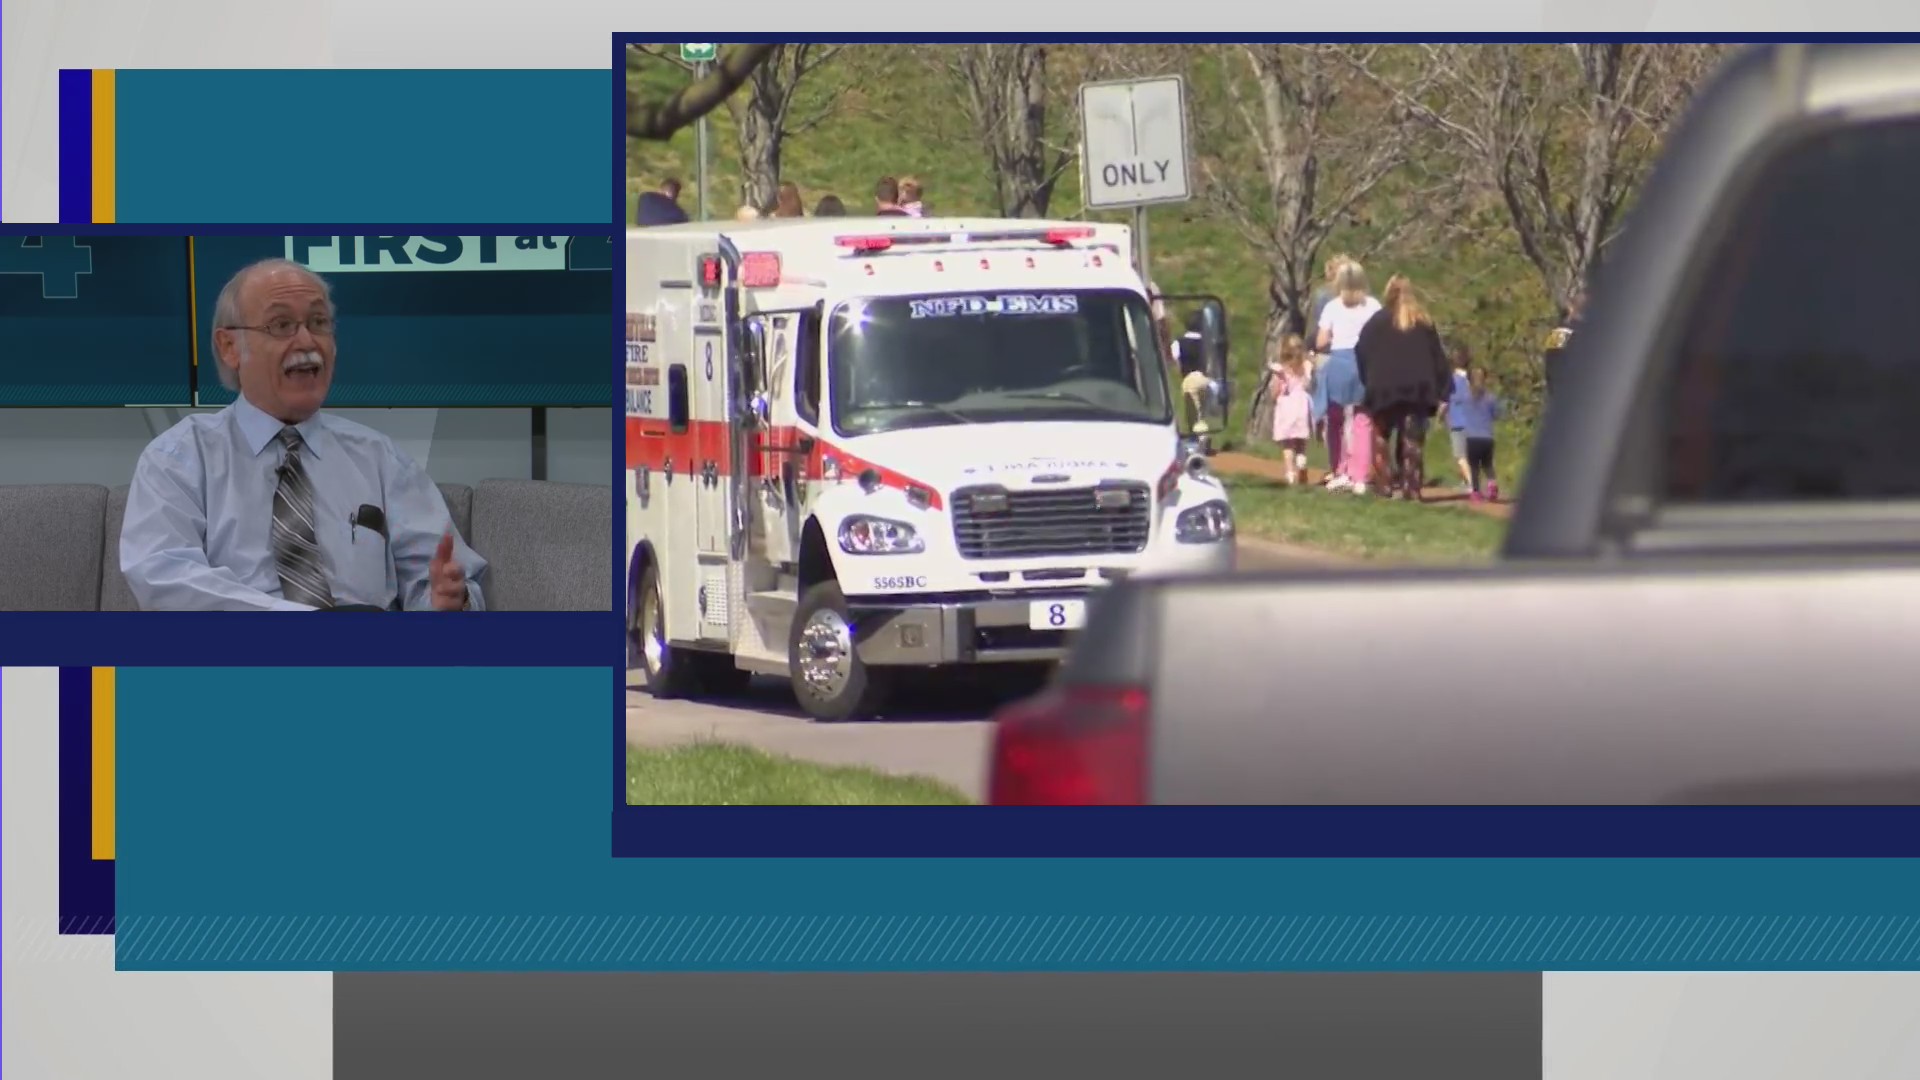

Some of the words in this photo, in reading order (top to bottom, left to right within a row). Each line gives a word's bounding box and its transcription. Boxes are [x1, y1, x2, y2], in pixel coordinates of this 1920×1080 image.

[1102, 159, 1169, 188] ONLY
[996, 294, 1079, 315] EMS
[705, 341, 714, 381] 8
[873, 575, 928, 590] 5565BC
[1049, 603, 1066, 627] 8
